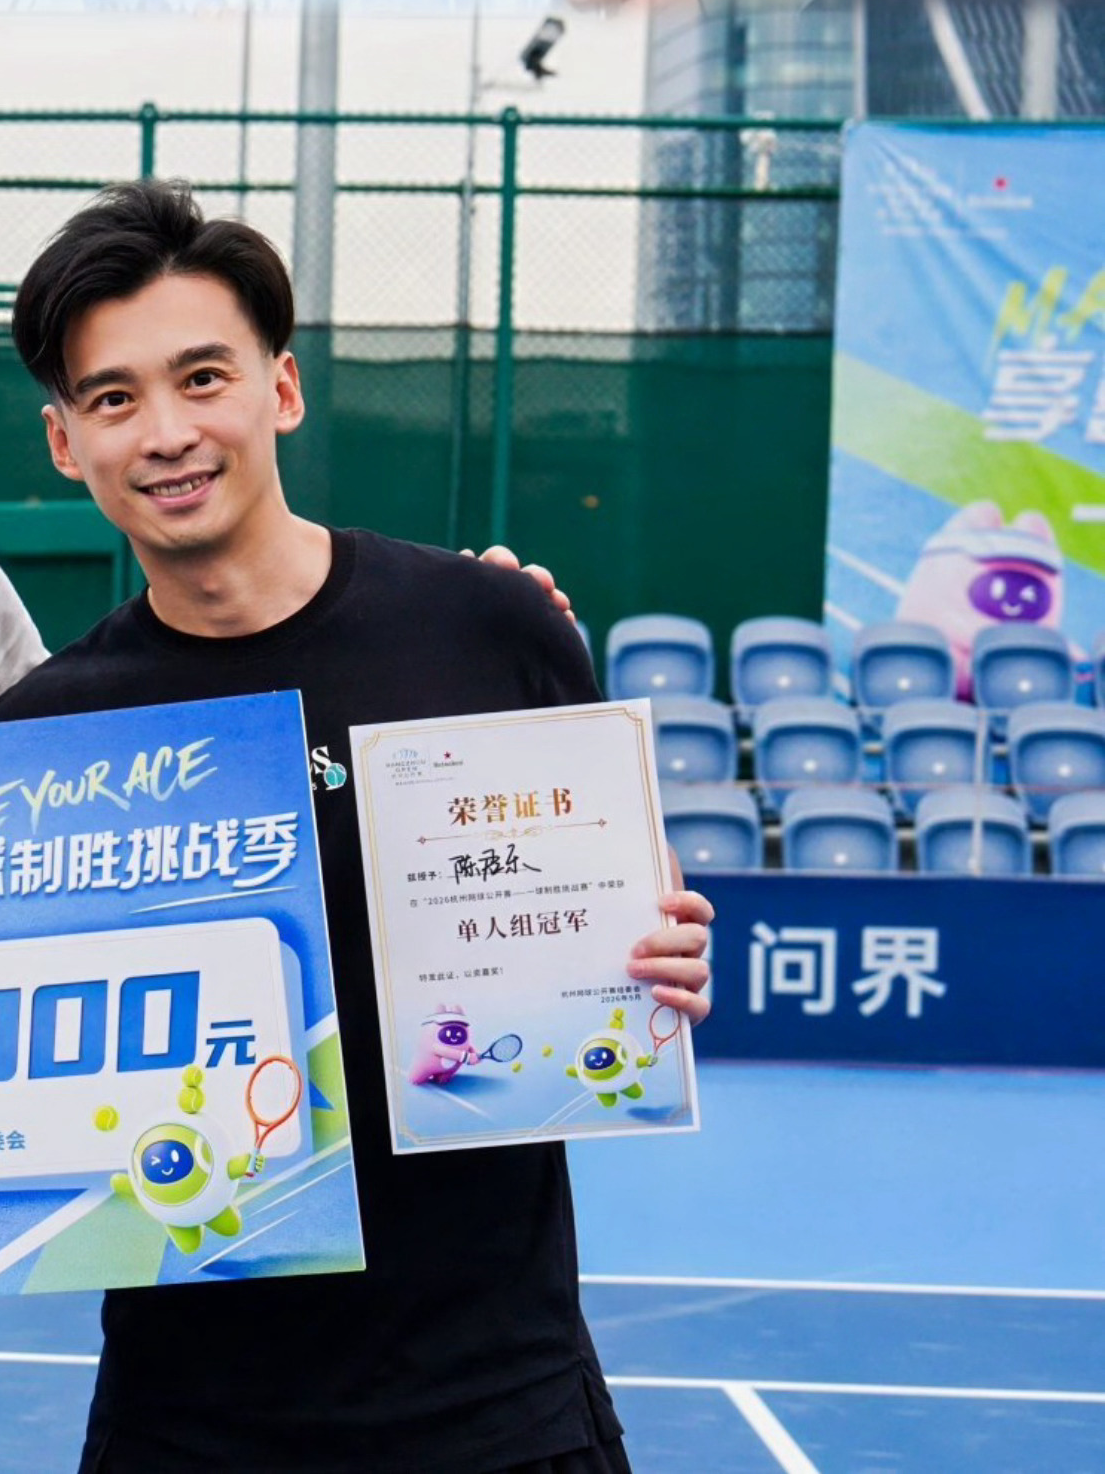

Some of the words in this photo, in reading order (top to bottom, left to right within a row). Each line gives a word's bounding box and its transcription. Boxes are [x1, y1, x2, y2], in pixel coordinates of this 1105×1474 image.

[982, 334, 1105, 441] 享
[123, 737, 218, 802] ACE
[448, 787, 572, 826] 荣誉证书
[457, 908, 589, 943] 单人组冠军
[748, 922, 947, 1019] 问界
